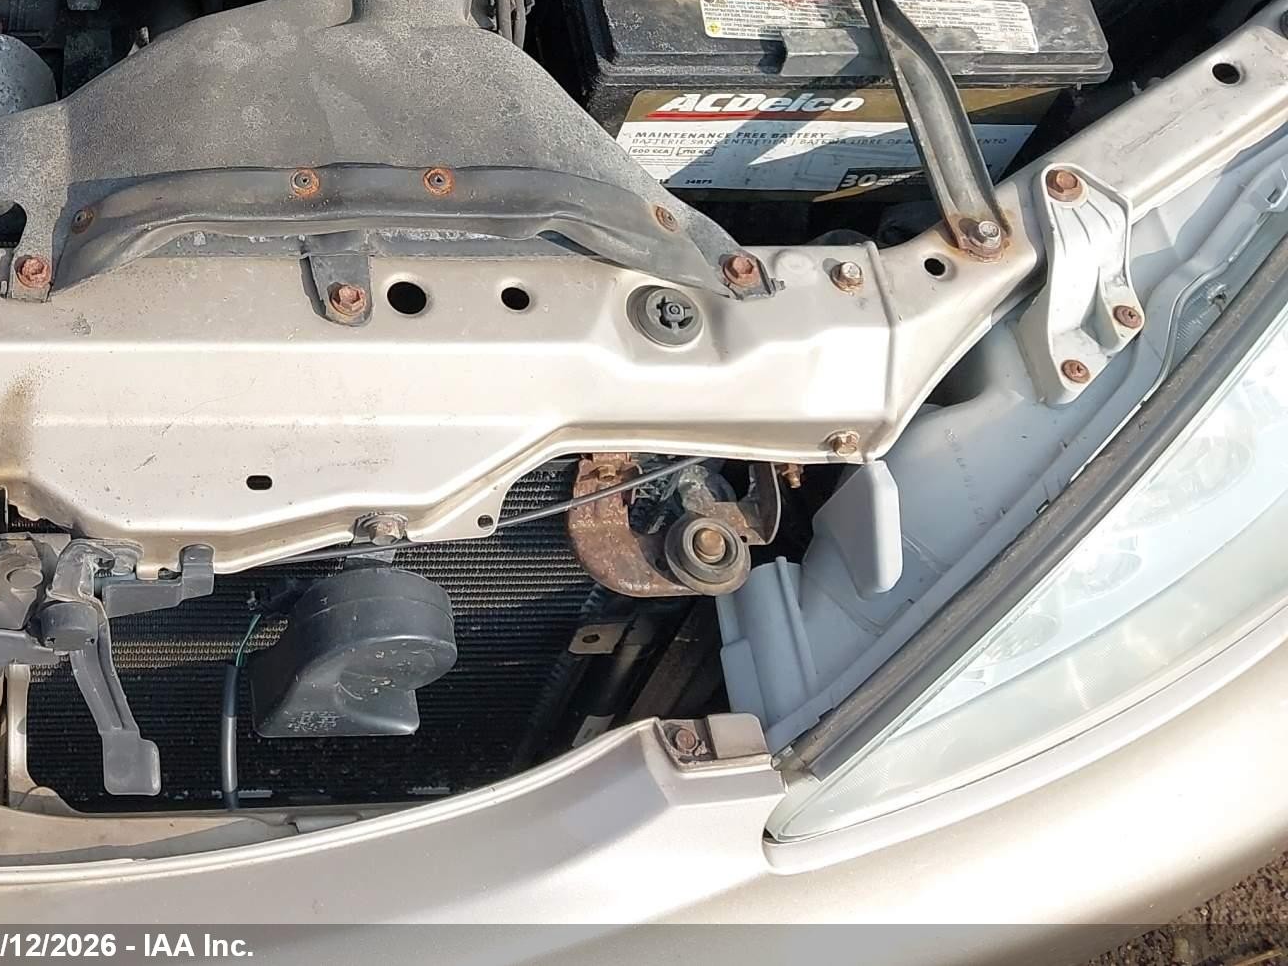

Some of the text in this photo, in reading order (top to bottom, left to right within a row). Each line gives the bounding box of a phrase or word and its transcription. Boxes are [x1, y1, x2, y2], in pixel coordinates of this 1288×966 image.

[655, 92, 866, 113] ACDelco
[634, 131, 732, 139] MAINTENANCE
[736, 131, 769, 139] FREE
[840, 174, 878, 187] 30
